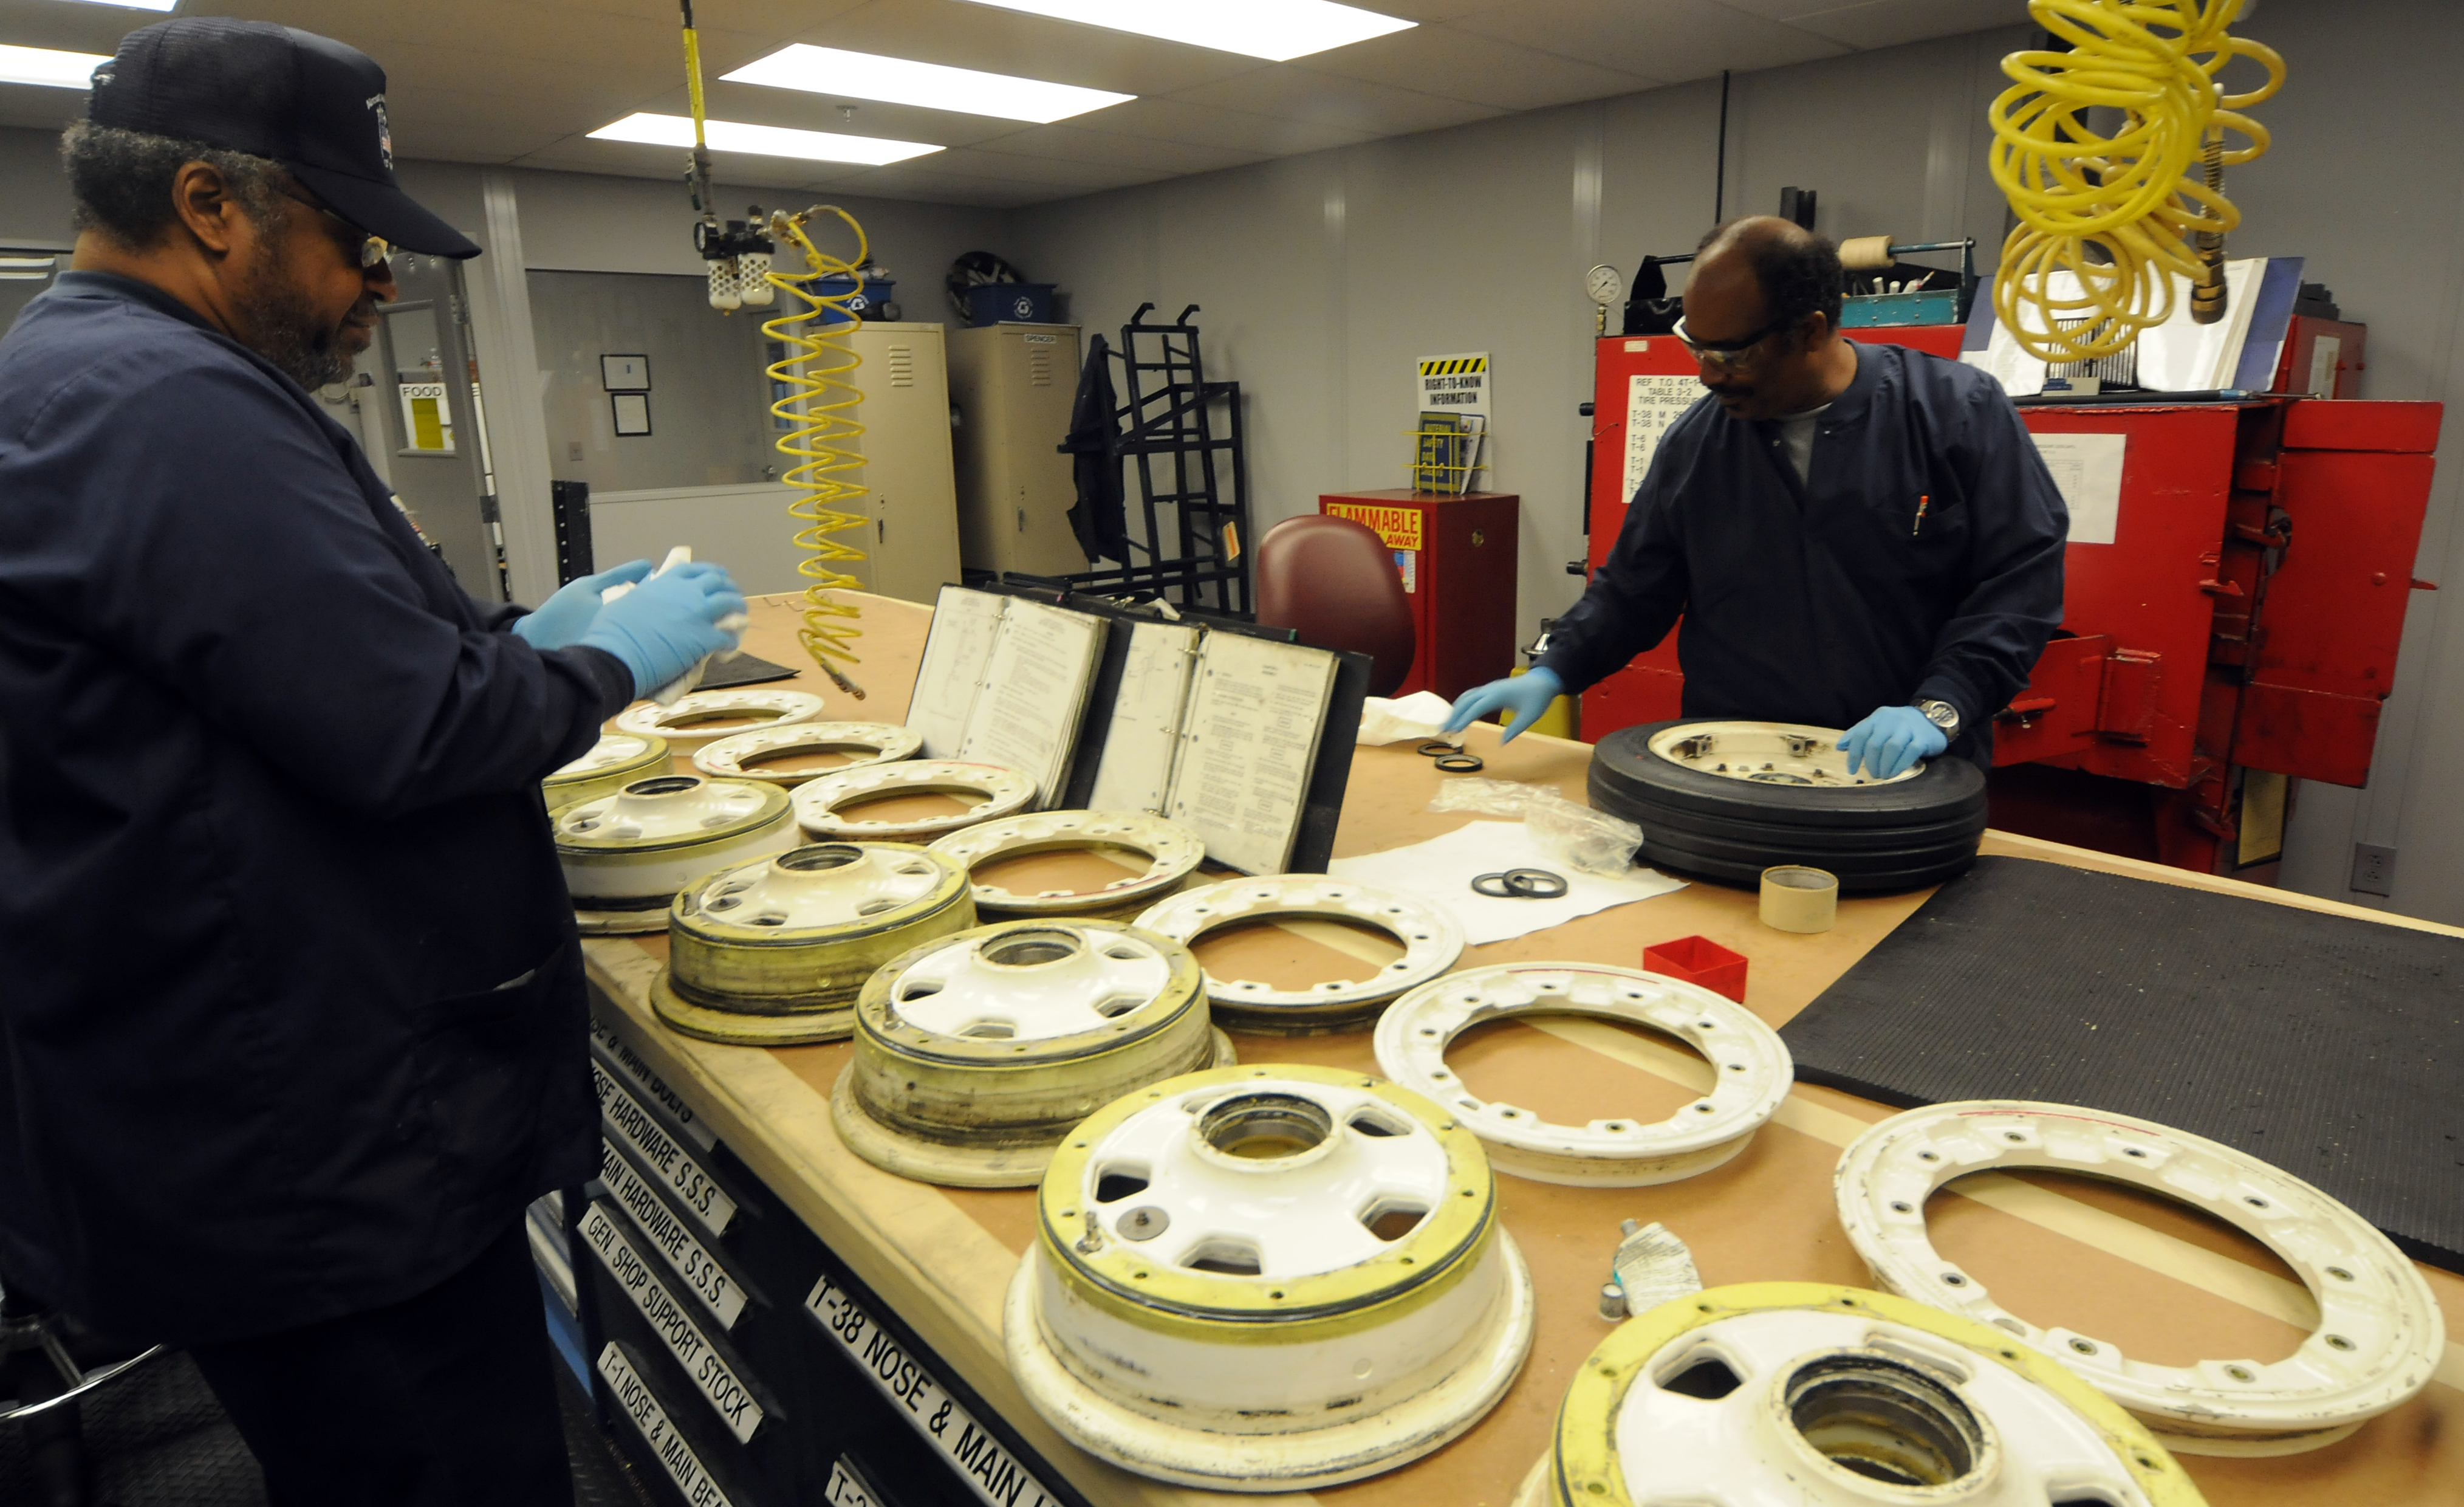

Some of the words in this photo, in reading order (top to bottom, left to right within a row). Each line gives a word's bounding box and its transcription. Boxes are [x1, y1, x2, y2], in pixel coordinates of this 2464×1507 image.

[1425, 376, 1482, 390] RIGHT-TO-KNOW
[403, 386, 442, 397] FOOD
[1430, 392, 1477, 405] INFORMATION
[1632, 419, 1652, 427] T-38
[1631, 465, 1643, 474] T-1
[1386, 534, 1419, 548] AWAY
[609, 1094, 680, 1174] HARDWARE
[675, 1161, 716, 1216] S.S.S.
[620, 1174, 690, 1260] HARDWARE
[685, 1249, 725, 1308] S.S.S.
[588, 1215, 615, 1255] GEN.
[613, 1246, 648, 1291] SHOP
[643, 1285, 703, 1363] SUPPORT
[699, 1354, 750, 1426] STOCK
[813, 1277, 866, 1344] T-38
[863, 1330, 932, 1413] NOSE
[929, 1399, 953, 1438] &
[953, 1421, 1027, 1507] MAIN
[604, 1350, 625, 1385] T-1
[620, 1374, 655, 1427] NOSE
[651, 1419, 665, 1443] &
[661, 1433, 697, 1487] MAIN
